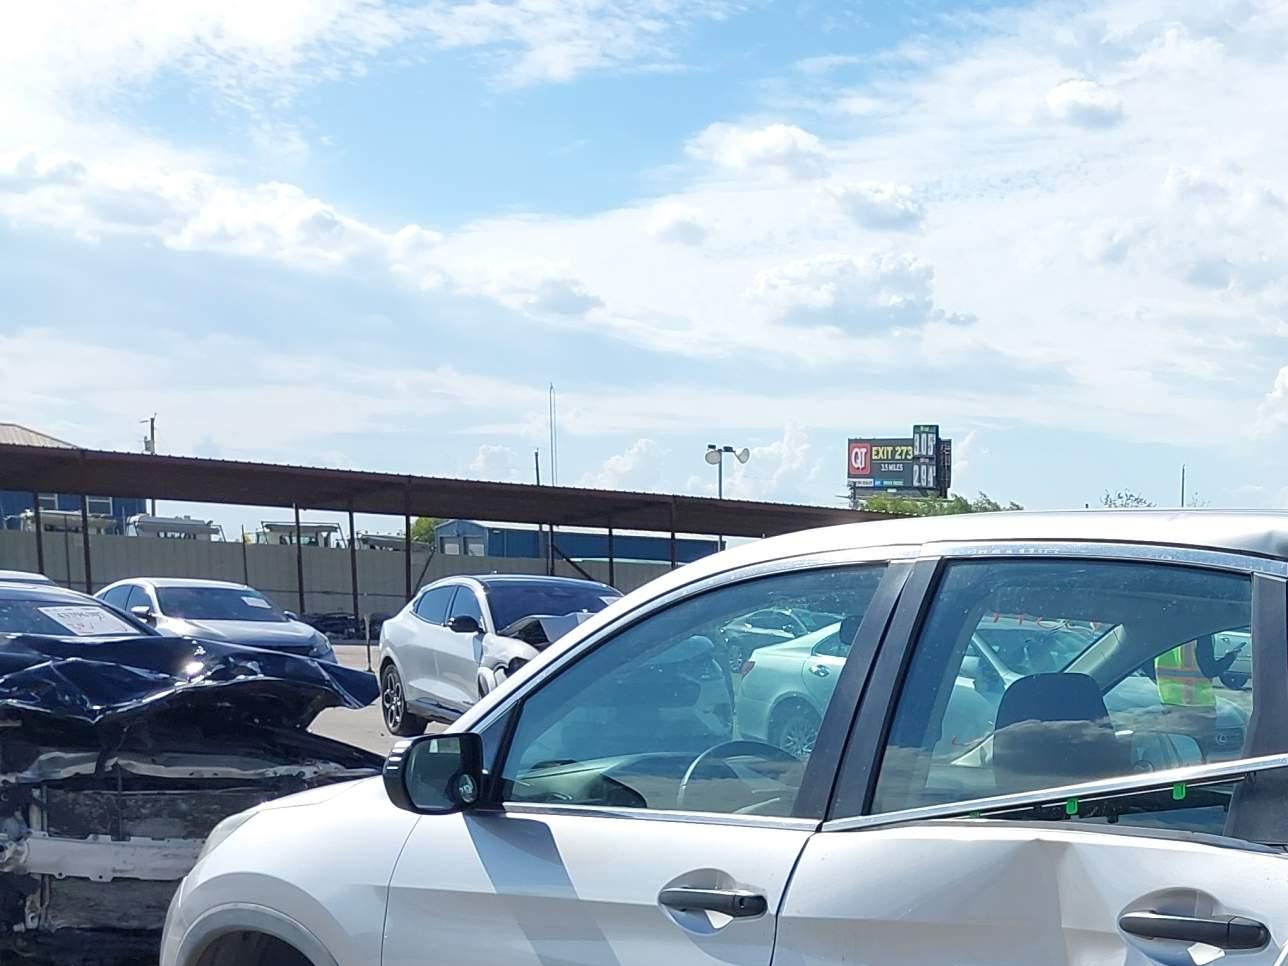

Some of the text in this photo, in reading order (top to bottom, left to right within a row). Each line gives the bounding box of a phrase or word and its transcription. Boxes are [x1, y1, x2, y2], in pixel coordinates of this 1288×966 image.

[851, 448, 867, 469] QT
[872, 446, 913, 460] EXIT 273
